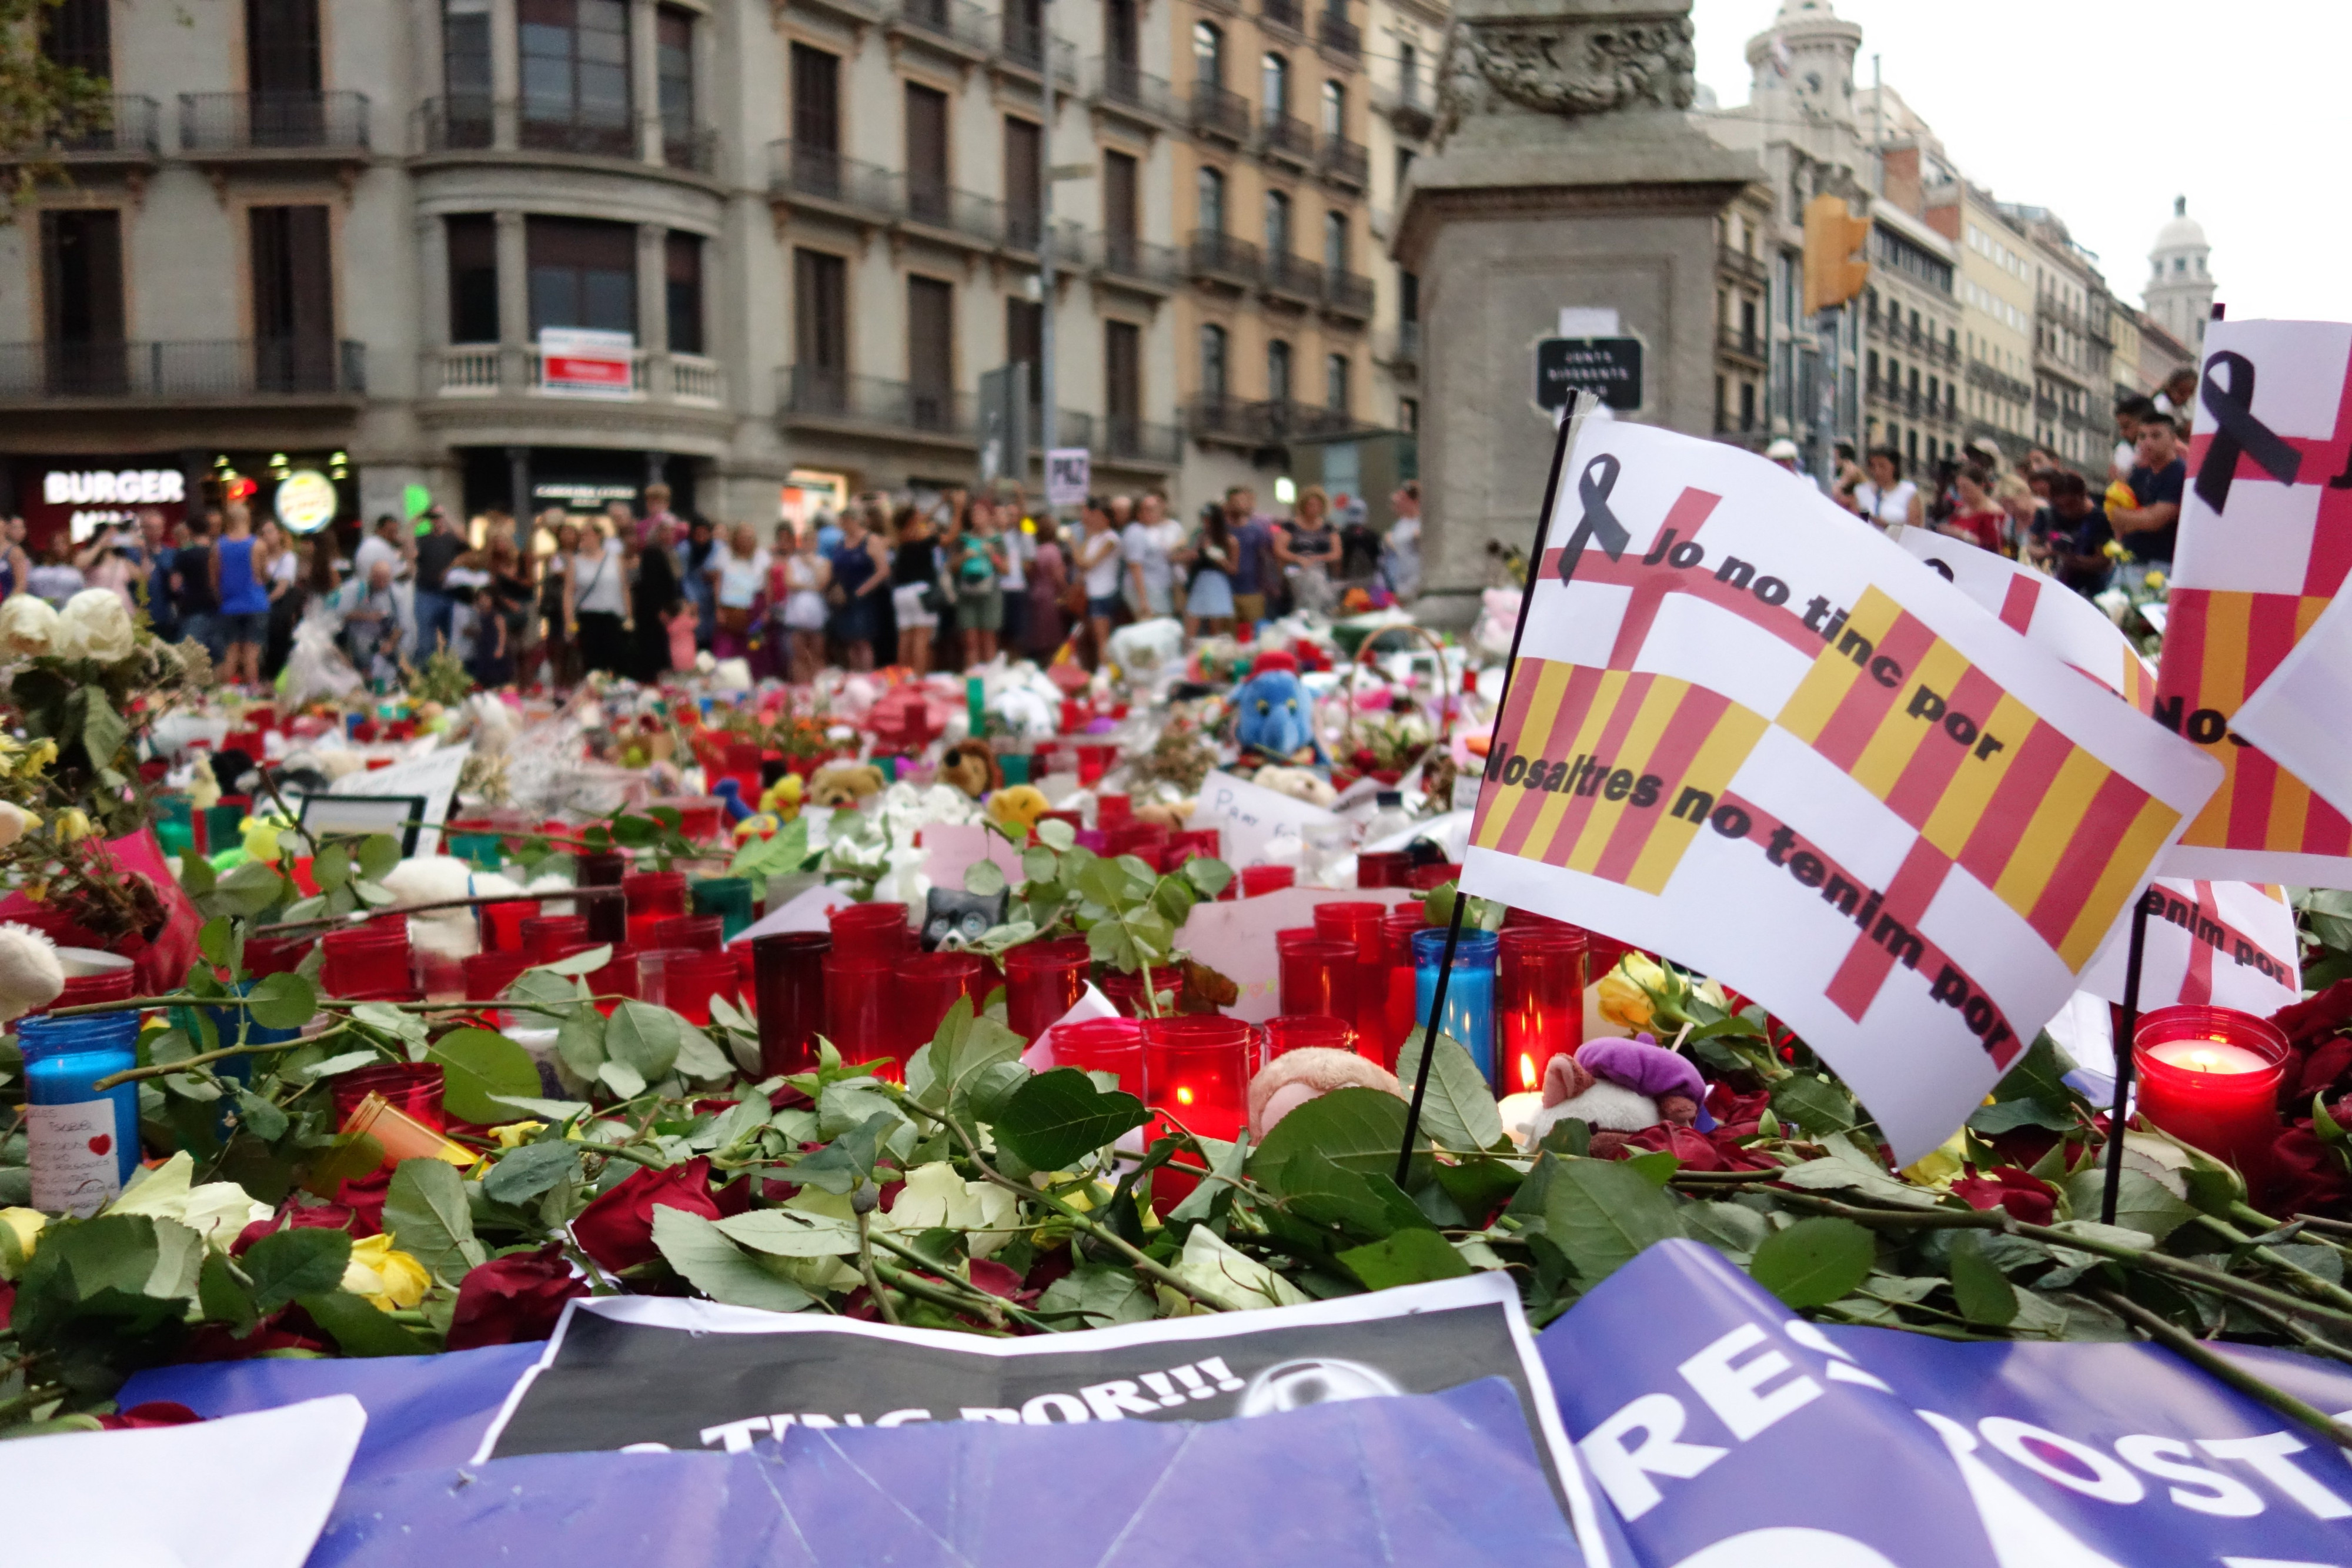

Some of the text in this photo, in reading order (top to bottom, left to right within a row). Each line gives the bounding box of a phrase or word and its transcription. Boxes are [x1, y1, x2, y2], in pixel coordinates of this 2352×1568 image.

[44, 470, 185, 504] BURGER
[1642, 528, 2004, 761] Jo no tinc por
[2152, 696, 2253, 747] No
[1486, 743, 2010, 1053] Nosaltres no tenim por
[2147, 890, 2285, 985] enim por
[960, 1356, 1246, 1425] OR!!!
